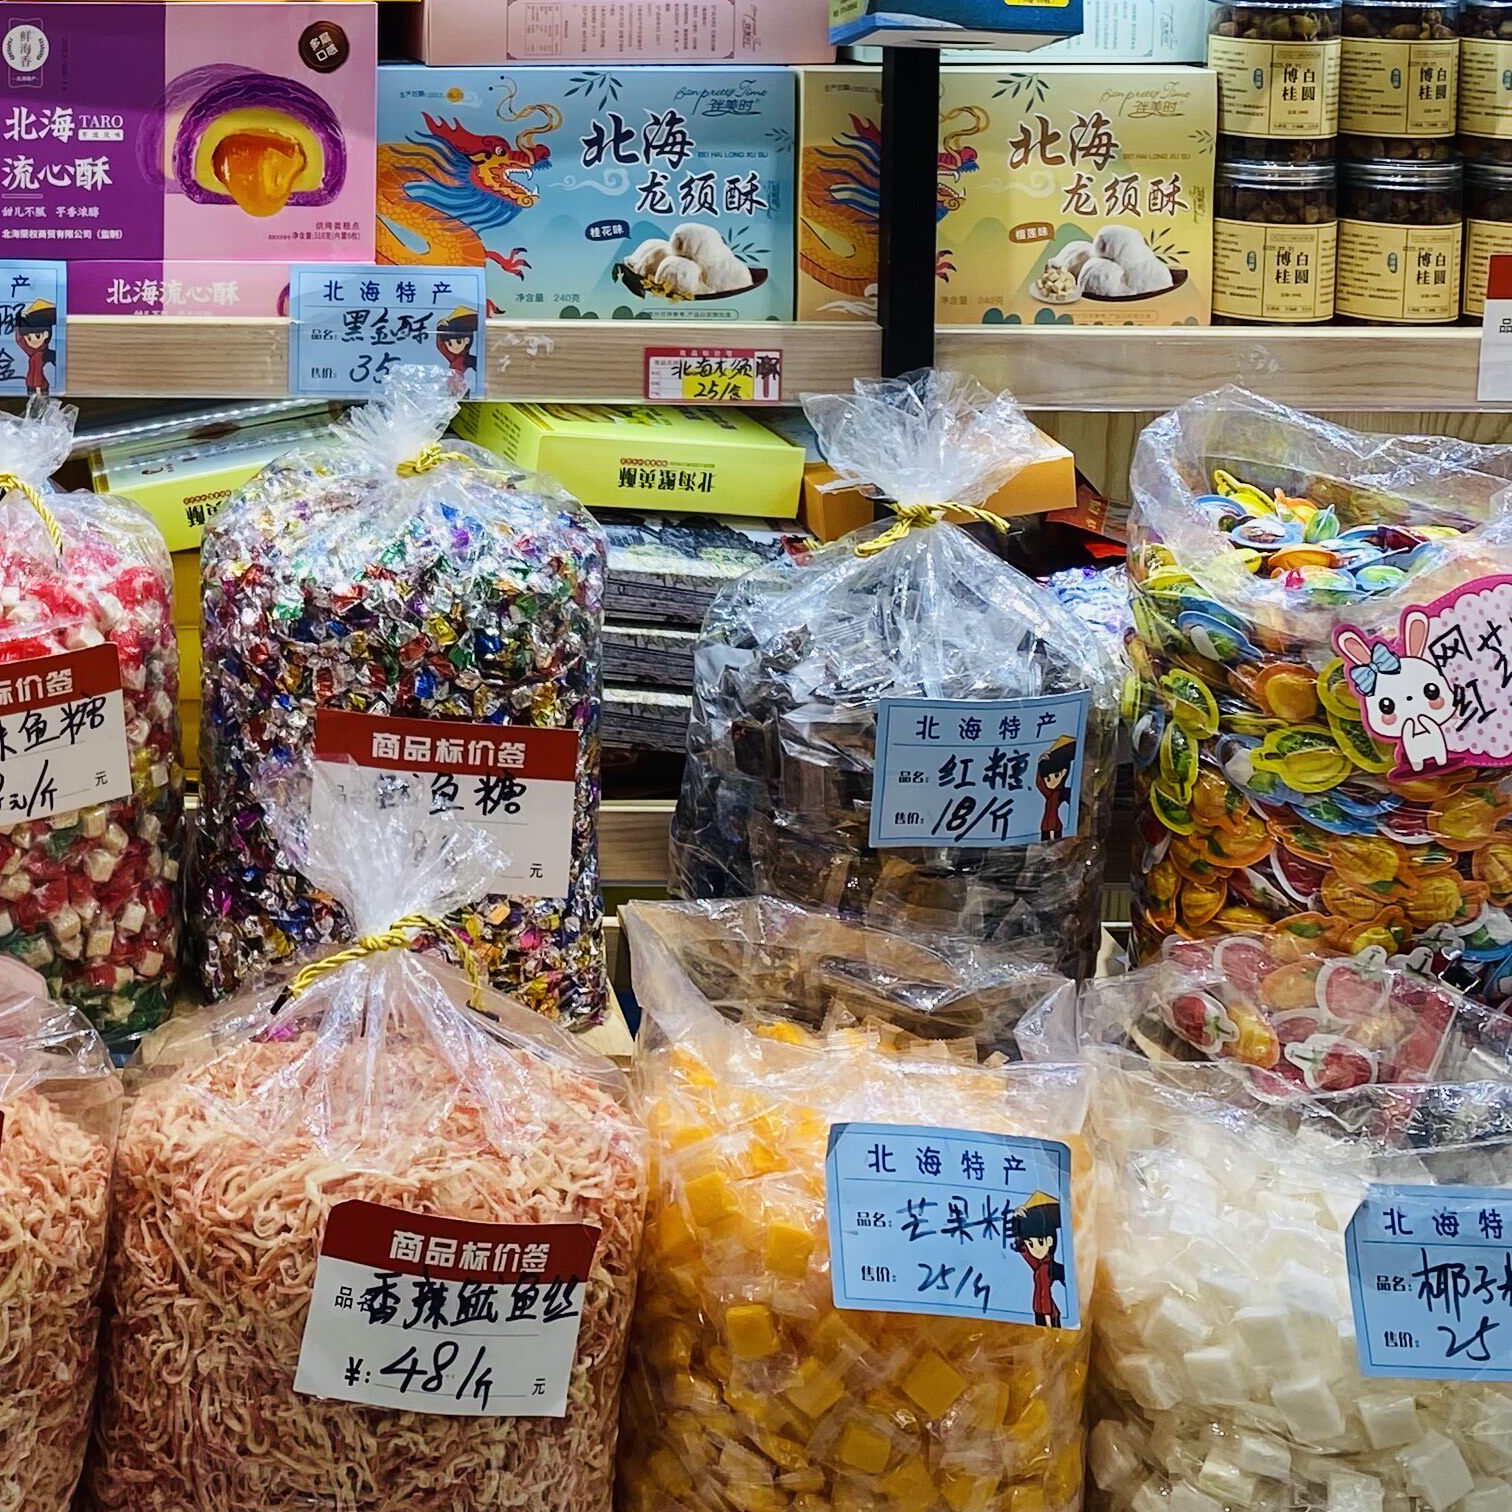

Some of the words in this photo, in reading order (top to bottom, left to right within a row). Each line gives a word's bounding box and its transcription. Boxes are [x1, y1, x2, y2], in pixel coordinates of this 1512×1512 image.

[3, 107, 76, 143] 北海
[78, 114, 124, 130] TARO
[581, 108, 695, 171] 北海
[1008, 111, 1121, 172] 北海
[1, 154, 113, 192] 流心酥
[635, 171, 770, 218] 龙须酥
[1060, 172, 1190, 218] 龙须酥
[106, 277, 240, 304] 北海流心酥
[323, 280, 454, 304] 北海特产
[916, 712, 1057, 740] 北海特产
[372, 731, 527, 769] 商品标价签
[868, 1144, 1027, 1185] 北海特产
[1383, 1207, 1504, 1239] 北海特
[389, 1230, 551, 1273] 商品标价签
[368, 1266, 579, 1330] 香辣鱿鱼丝
[1438, 1316, 1500, 1361] 25
